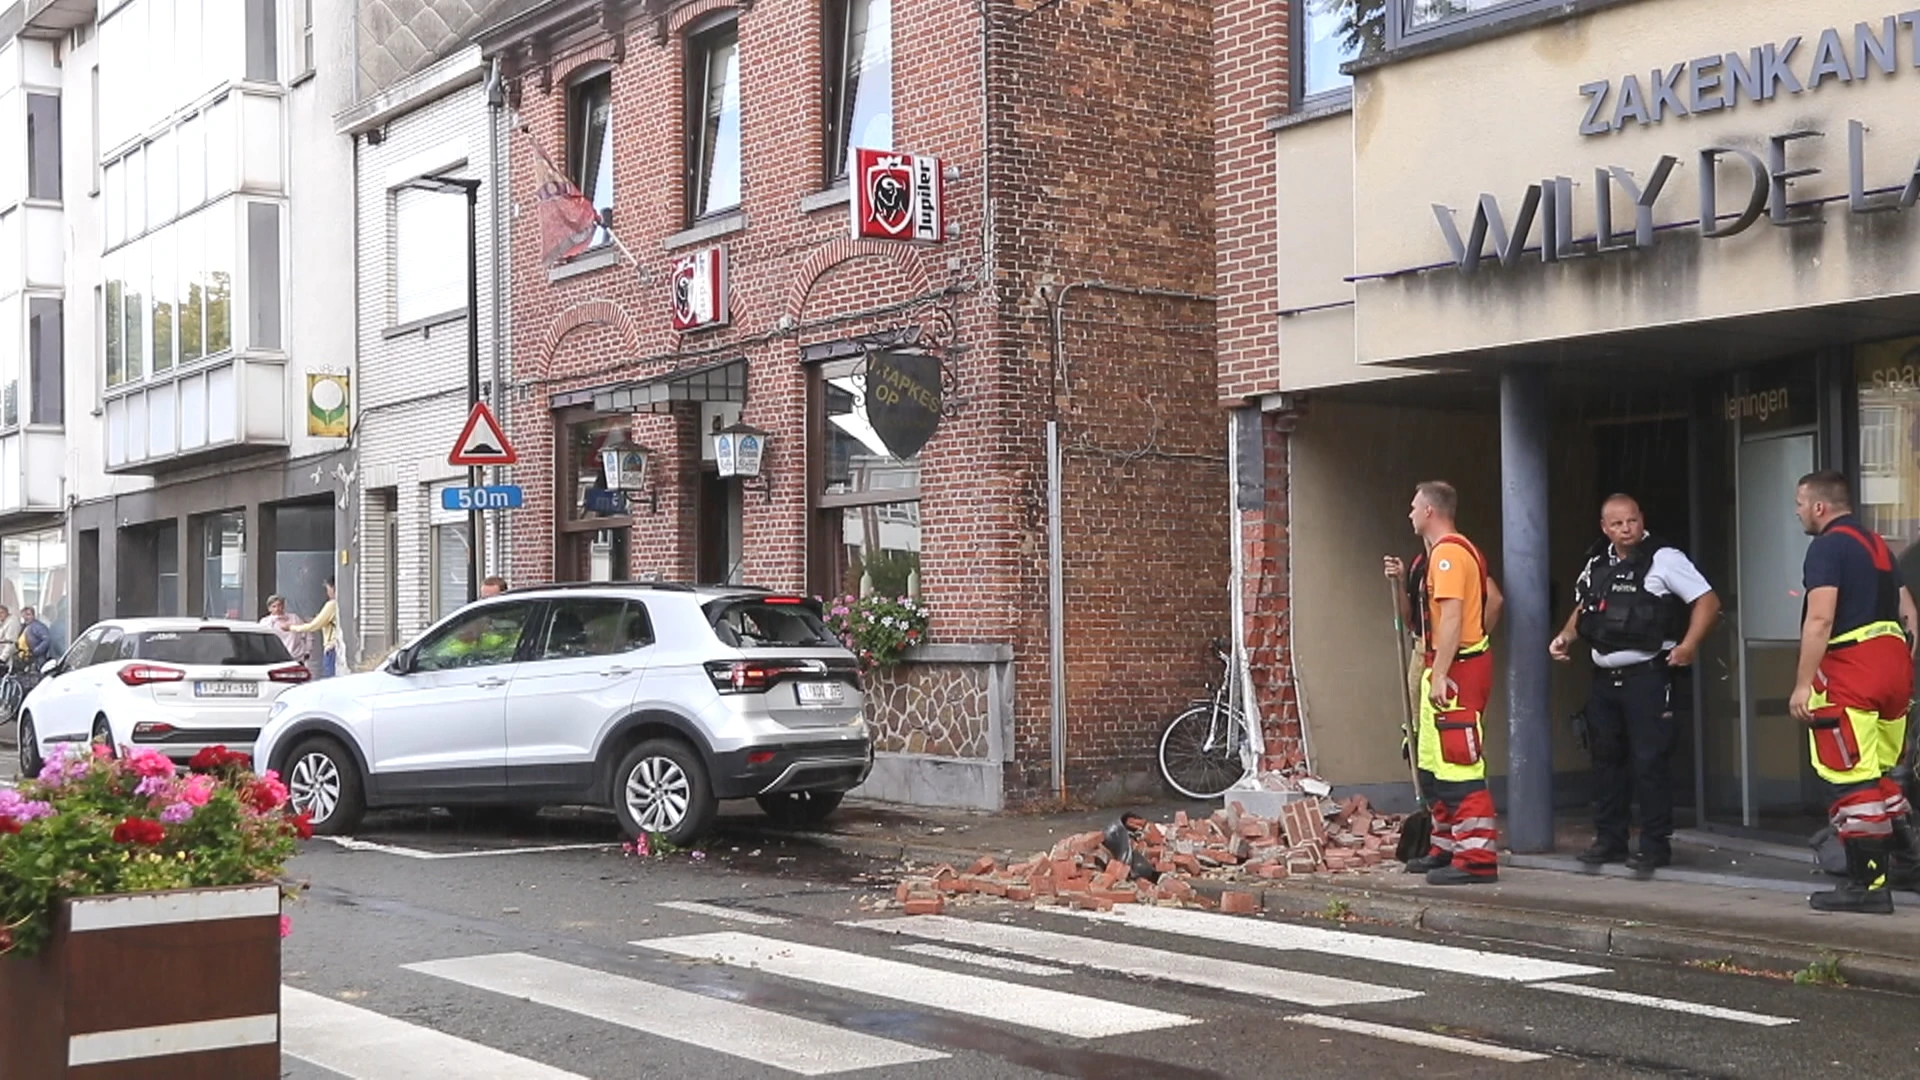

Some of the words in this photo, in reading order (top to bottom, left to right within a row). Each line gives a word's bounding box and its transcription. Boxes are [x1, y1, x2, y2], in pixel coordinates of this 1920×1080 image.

[917, 159, 935, 237] Jupiler
[1432, 154, 1677, 272] WILLY
[1701, 130, 1824, 239] DE
[1848, 119, 1920, 213] L
[875, 384, 900, 406] OP
[1724, 387, 1788, 421] leningen
[458, 488, 509, 508] 50m
